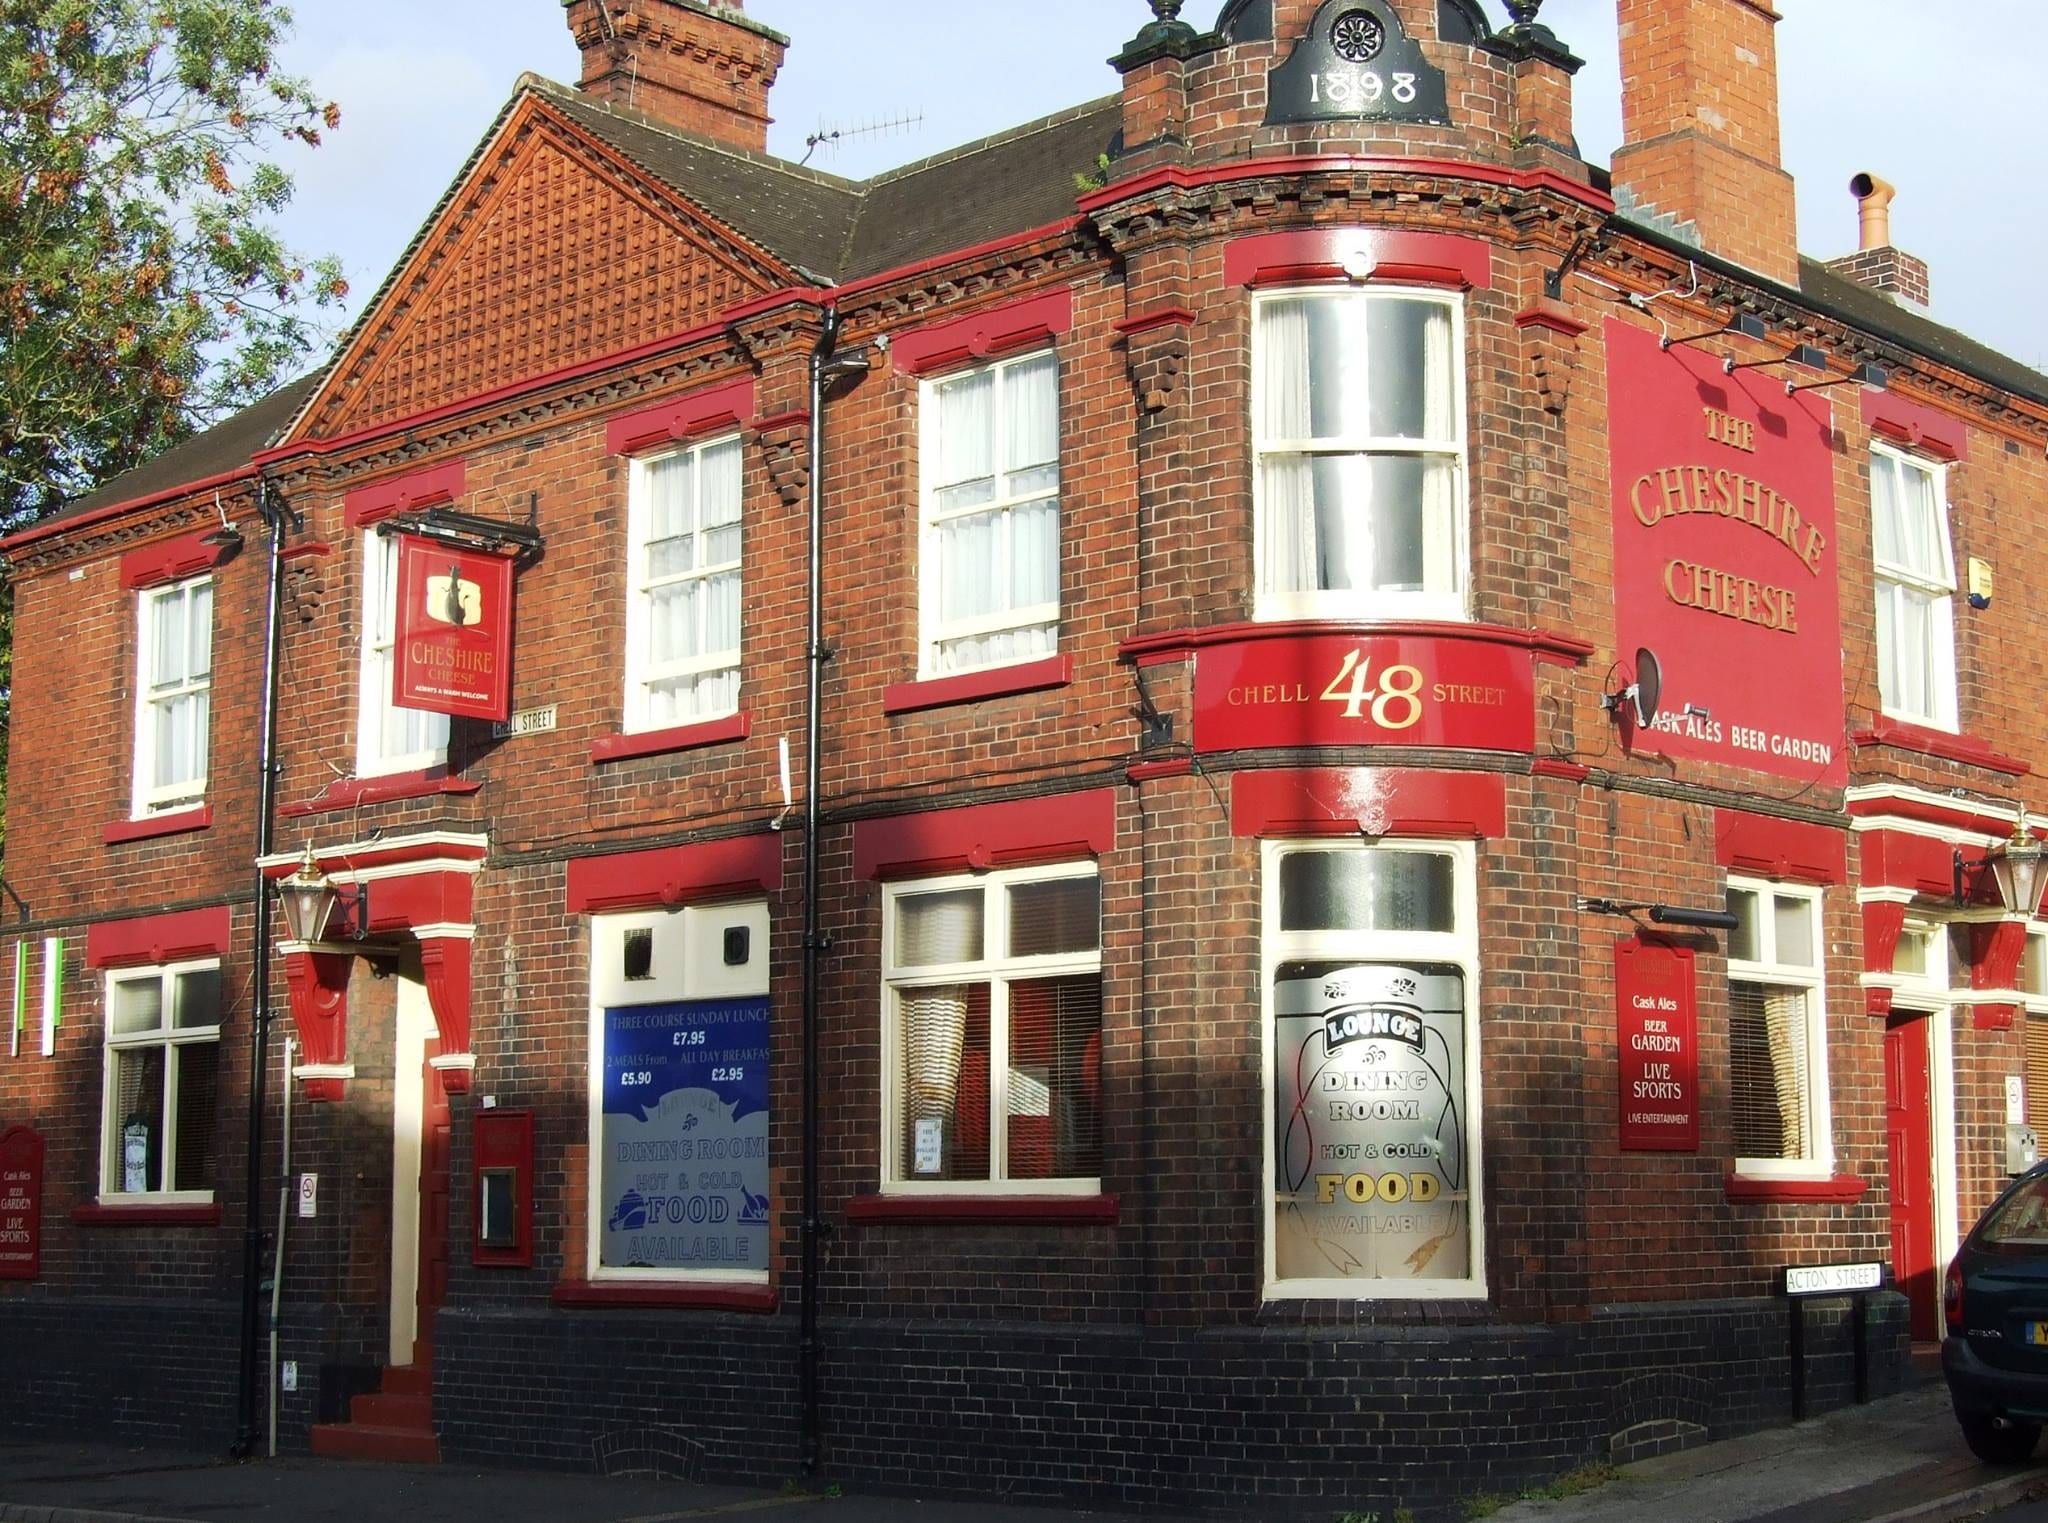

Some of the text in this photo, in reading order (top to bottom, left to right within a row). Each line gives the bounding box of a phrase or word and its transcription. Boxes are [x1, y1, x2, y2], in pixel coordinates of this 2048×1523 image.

[1310, 72, 1416, 103] 1898
[1703, 407, 1755, 453] THE
[1630, 465, 1828, 577] CHESHIRE
[1663, 558, 1798, 633] CHEESE
[411, 641, 492, 674] CHESHIRE
[428, 668, 476, 686] CHEESE
[1228, 648, 1506, 729] CHELL 48 STREET
[523, 710, 552, 730] STREET
[1649, 710, 1831, 764] ASK ALES BEER GARDEN
[1633, 995, 1677, 1011] Cask Ales
[613, 1016, 642, 1029] THREE
[644, 1014, 684, 1028] COURSE
[687, 1010, 731, 1026] SUNDAY
[1327, 1011, 1420, 1042] LOUNGE
[1644, 1019, 1667, 1033] BEER
[673, 1031, 705, 1046] £7.95
[1631, 1035, 1681, 1052] GARDEN
[612, 1055, 643, 1066] MEALS
[645, 1054, 667, 1066] From
[681, 1051, 697, 1064] ALL
[700, 1050, 723, 1063] DAY
[723, 1048, 769, 1062] BREAKFAS
[621, 1071, 651, 1085] £5.90
[712, 1068, 743, 1082] £2.95
[1323, 1071, 1427, 1091] DINING
[1644, 1063, 1670, 1080] LIVE
[1633, 1082, 1681, 1099] SPORTS
[1330, 1100, 1419, 1121] ROOM
[1628, 1112, 1688, 1125] LIVE ENTERTAINMENT
[617, 1137, 765, 1162] DINING ROOM
[1321, 1143, 1431, 1159] HOT & COLD
[637, 1171, 742, 1191] HOT & COLD
[1315, 1172, 1440, 1203] FOOD
[1, 1198, 31, 1210] GARDEN
[648, 1195, 729, 1224] FOOD
[7, 1217, 23, 1230] LIVE
[1314, 1214, 1446, 1235] AVAILABLE
[0, 1230, 30, 1243] SPORTS
[628, 1235, 749, 1262] AVAILABLE
[1787, 1267, 1876, 1288] ACTON STREET
